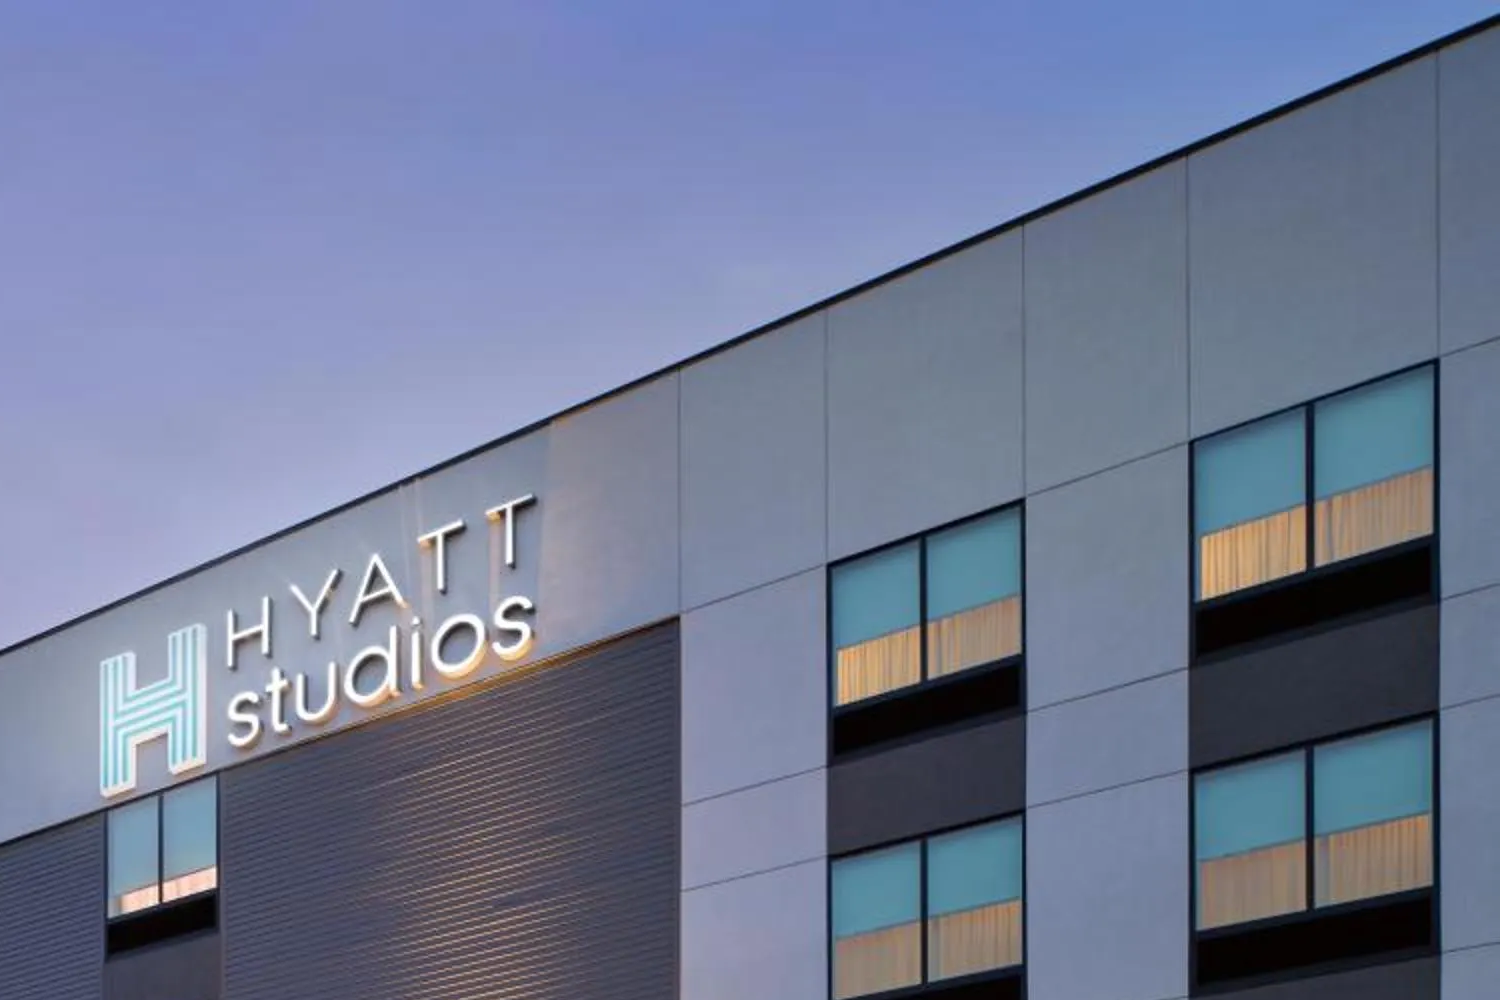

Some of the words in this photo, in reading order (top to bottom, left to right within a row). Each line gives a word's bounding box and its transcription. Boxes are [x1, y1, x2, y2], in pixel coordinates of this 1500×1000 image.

[227, 494, 536, 669] HYATT
[100, 624, 206, 798] H
[227, 597, 535, 749] studios
